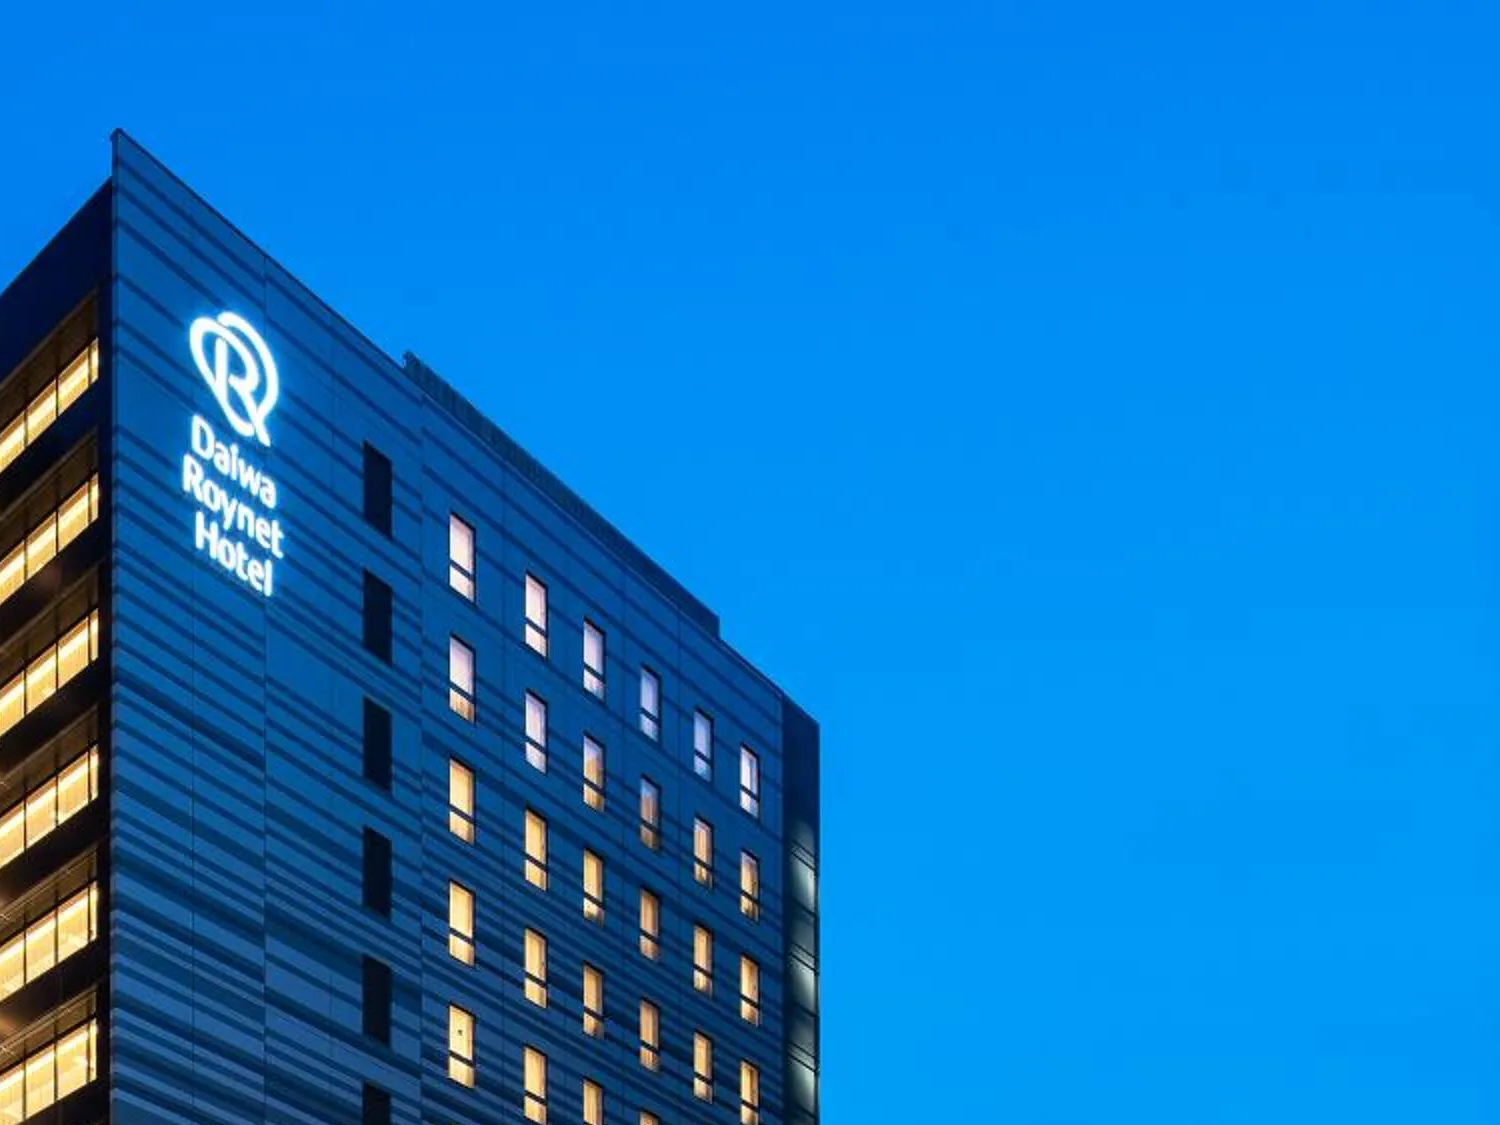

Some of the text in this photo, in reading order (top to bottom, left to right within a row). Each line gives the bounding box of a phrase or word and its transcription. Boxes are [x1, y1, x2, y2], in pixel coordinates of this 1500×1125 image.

[182, 453, 285, 559] Roynet
[191, 414, 277, 509] Daiwa
[194, 511, 273, 597] Hotel
